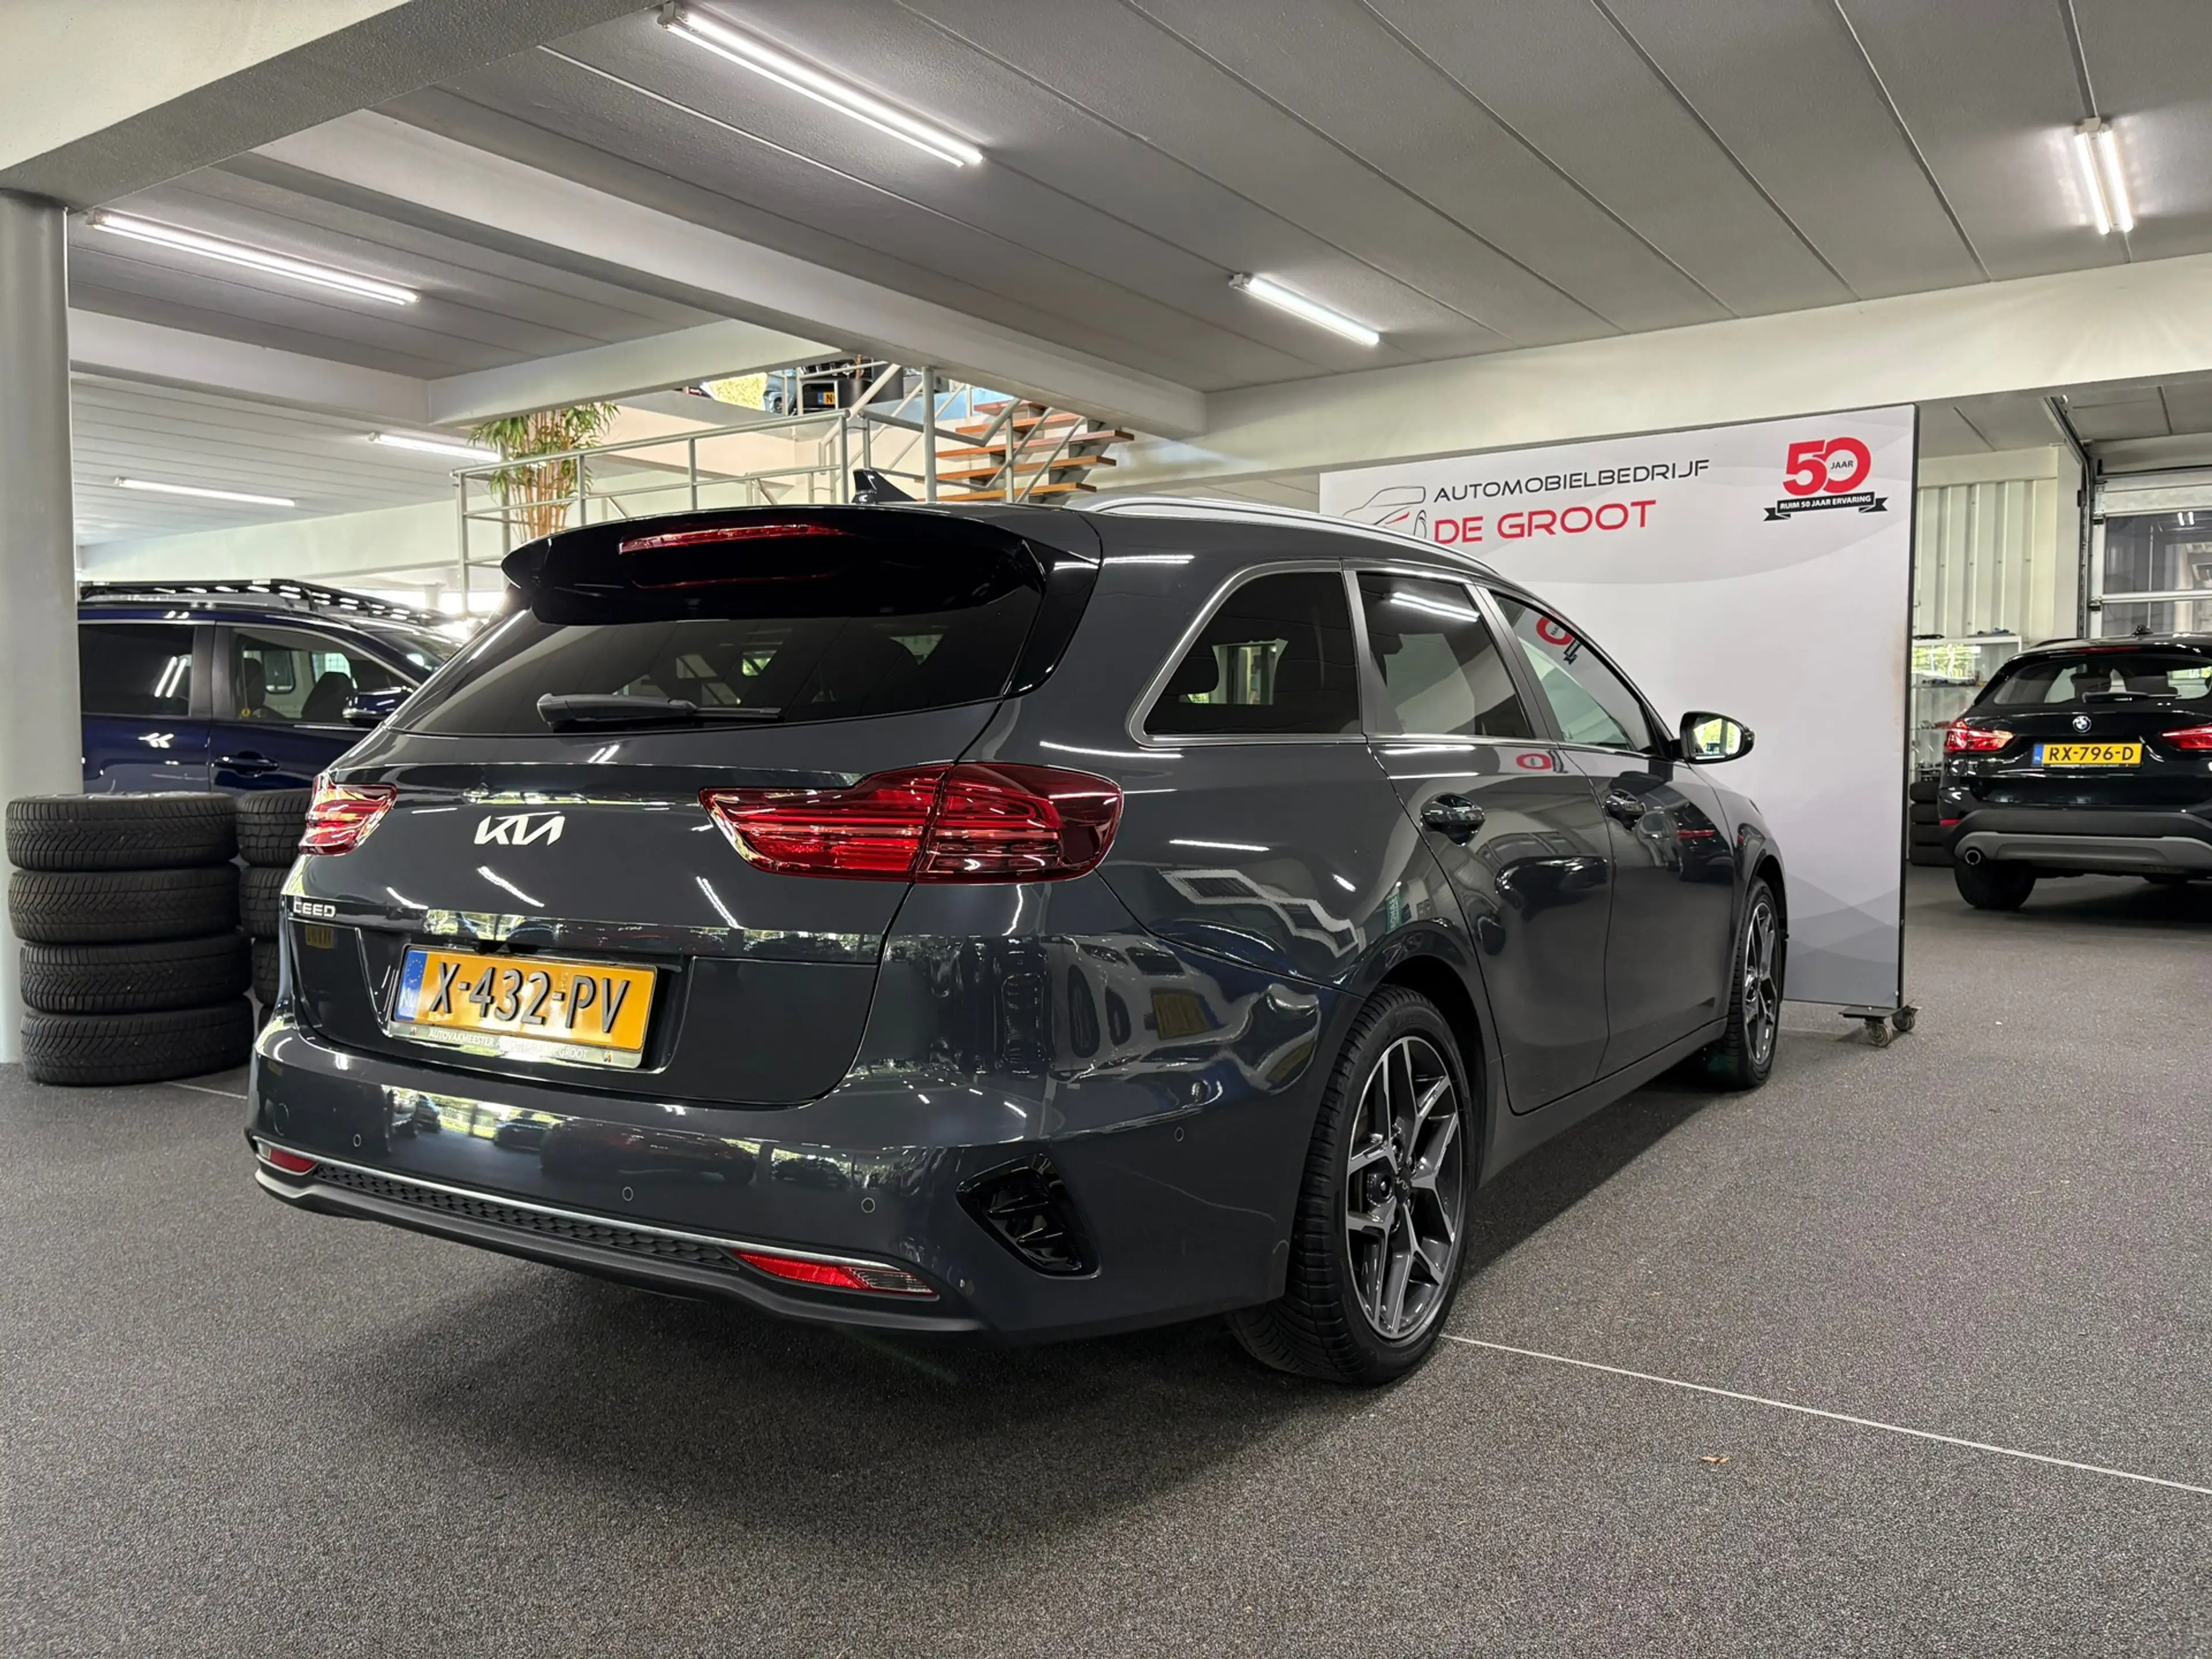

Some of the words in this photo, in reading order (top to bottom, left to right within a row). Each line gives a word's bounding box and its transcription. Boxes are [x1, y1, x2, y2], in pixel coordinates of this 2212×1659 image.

[1783, 437, 1872, 496] 50
[1830, 460, 1854, 469] JAAR
[1433, 459, 1710, 503] AUTOMOBIELBEDRIJF
[1780, 501, 1800, 510] RUIM
[1811, 498, 1831, 507] JAAR
[1832, 495, 1872, 506] ERVARING
[1434, 516, 1483, 545] DE
[1497, 499, 1657, 540] GROOT
[2049, 746, 2134, 761] RX-796-D
[474, 815, 566, 846] KIA
[293, 902, 336, 918] CEED
[428, 961, 631, 1033] X-432-PV
[429, 1028, 494, 1047] AUTOVAKMEESTER
[559, 1046, 588, 1059] GROOT
